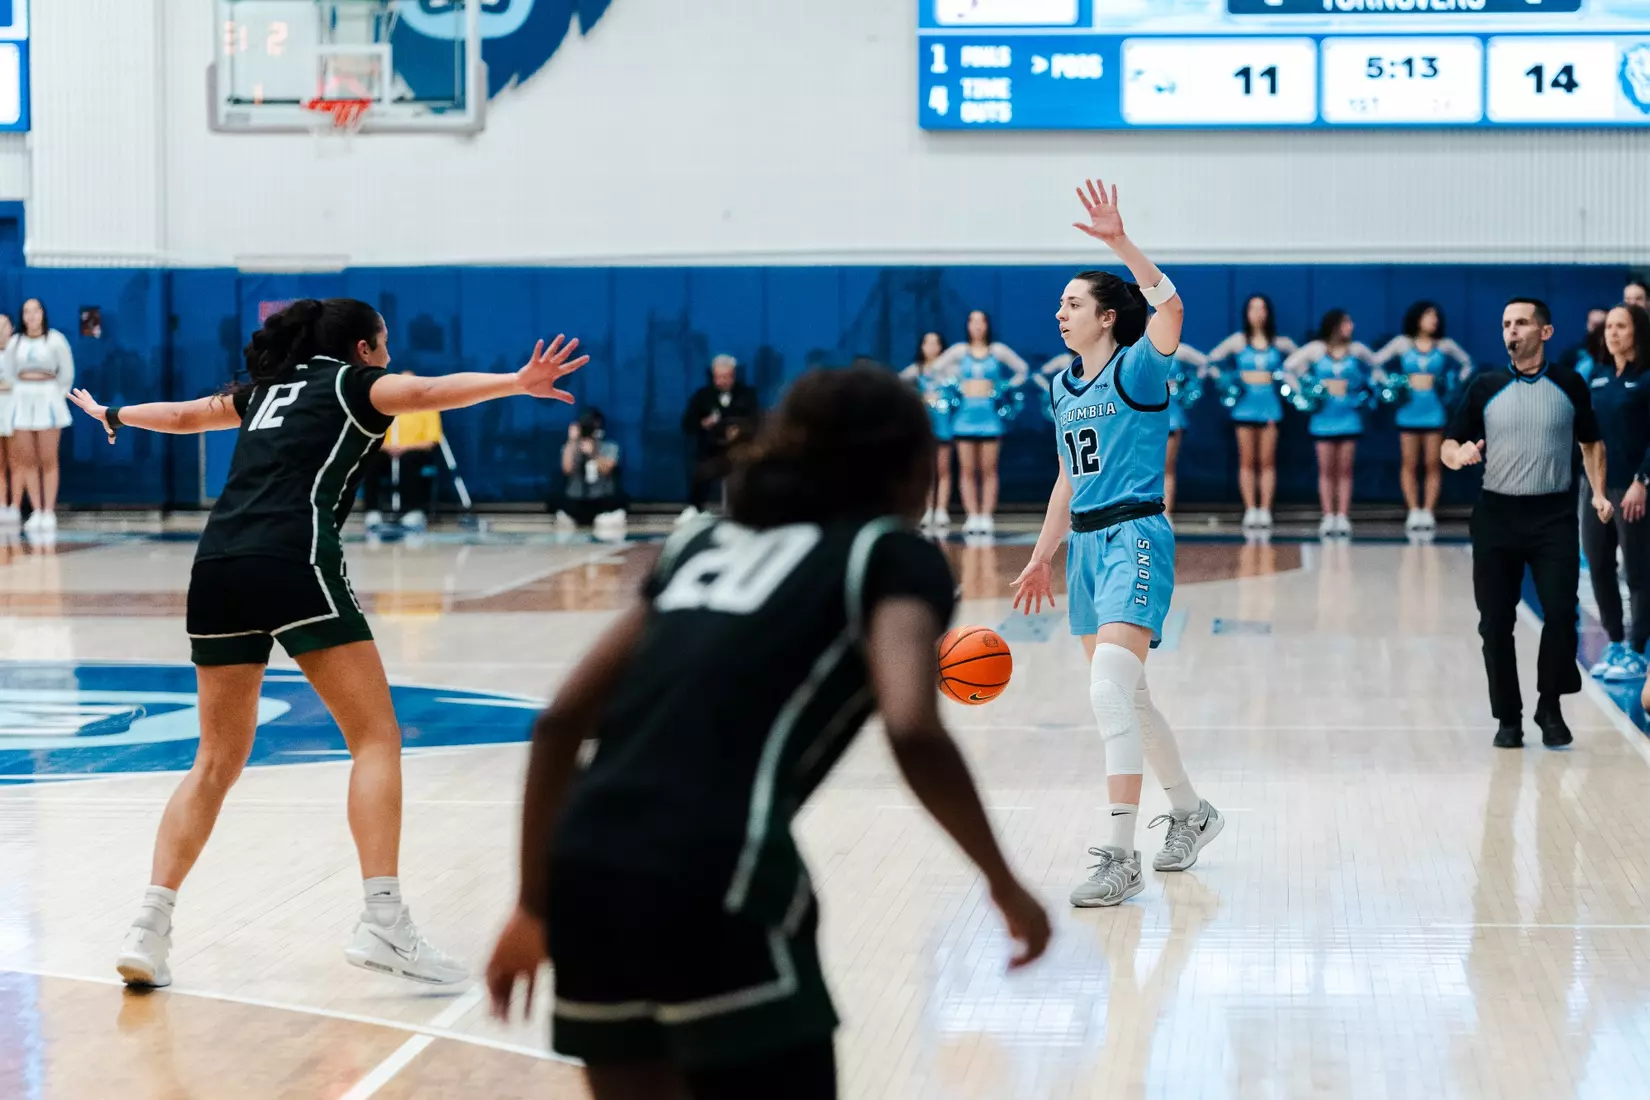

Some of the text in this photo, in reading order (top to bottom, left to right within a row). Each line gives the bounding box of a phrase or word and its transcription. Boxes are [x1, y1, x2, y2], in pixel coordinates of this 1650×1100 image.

[1234, 65, 1278, 96] 11
[1366, 56, 1439, 79] 5:13
[1525, 64, 1579, 94] 14
[248, 380, 308, 432] 12
[1063, 426, 1101, 478] 12
[655, 518, 823, 615] 20
[1134, 538, 1151, 607] LIONS
